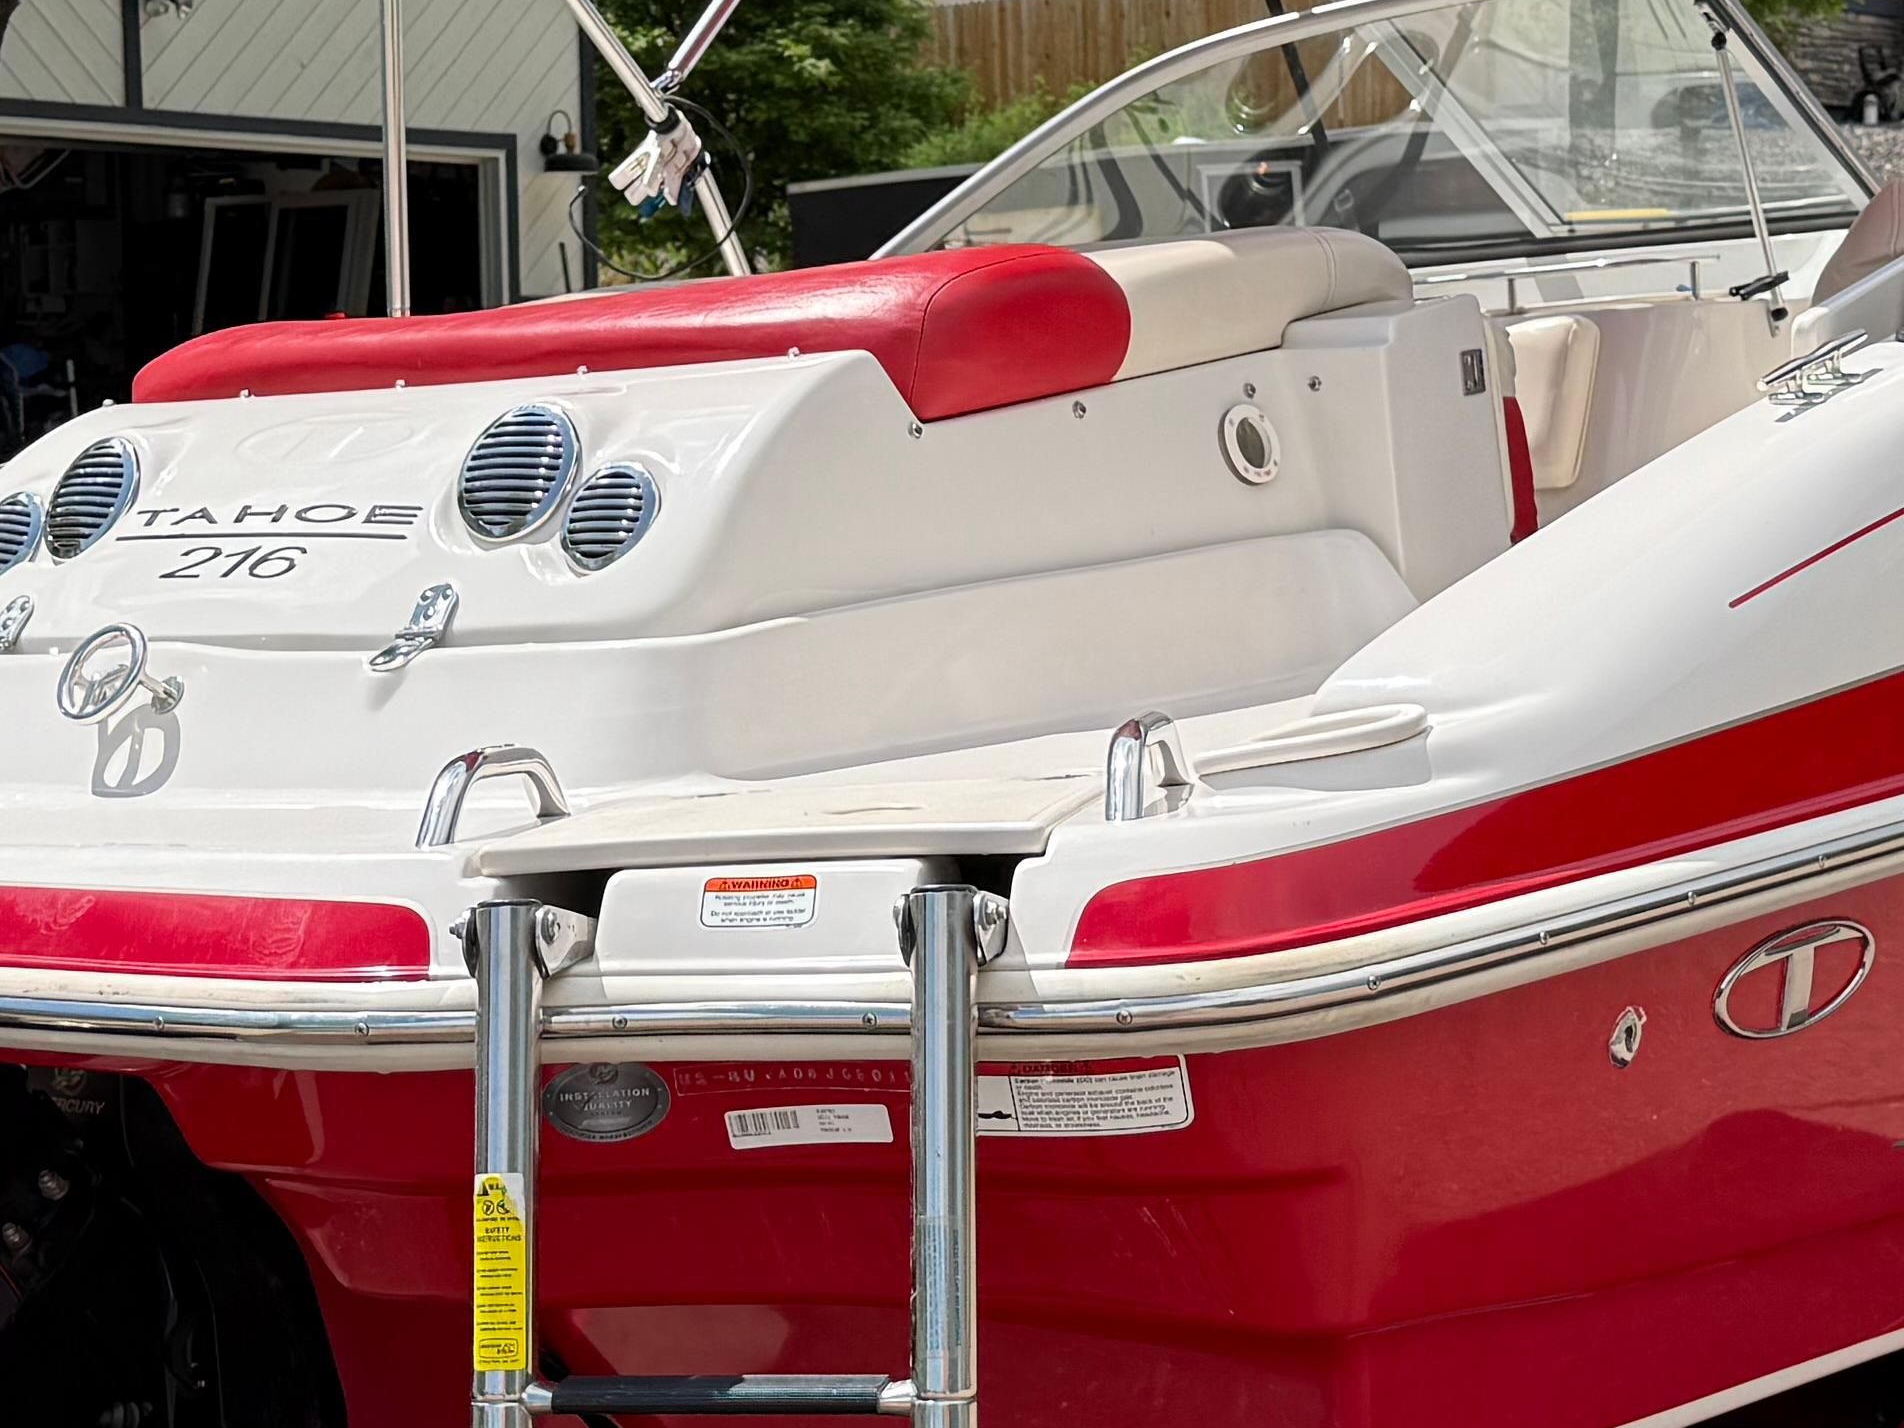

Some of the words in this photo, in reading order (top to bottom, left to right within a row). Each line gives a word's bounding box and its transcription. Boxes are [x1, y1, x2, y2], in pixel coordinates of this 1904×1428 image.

[137, 504, 423, 527] TAHOE
[159, 546, 307, 579] 216
[731, 878, 789, 890] WARNING
